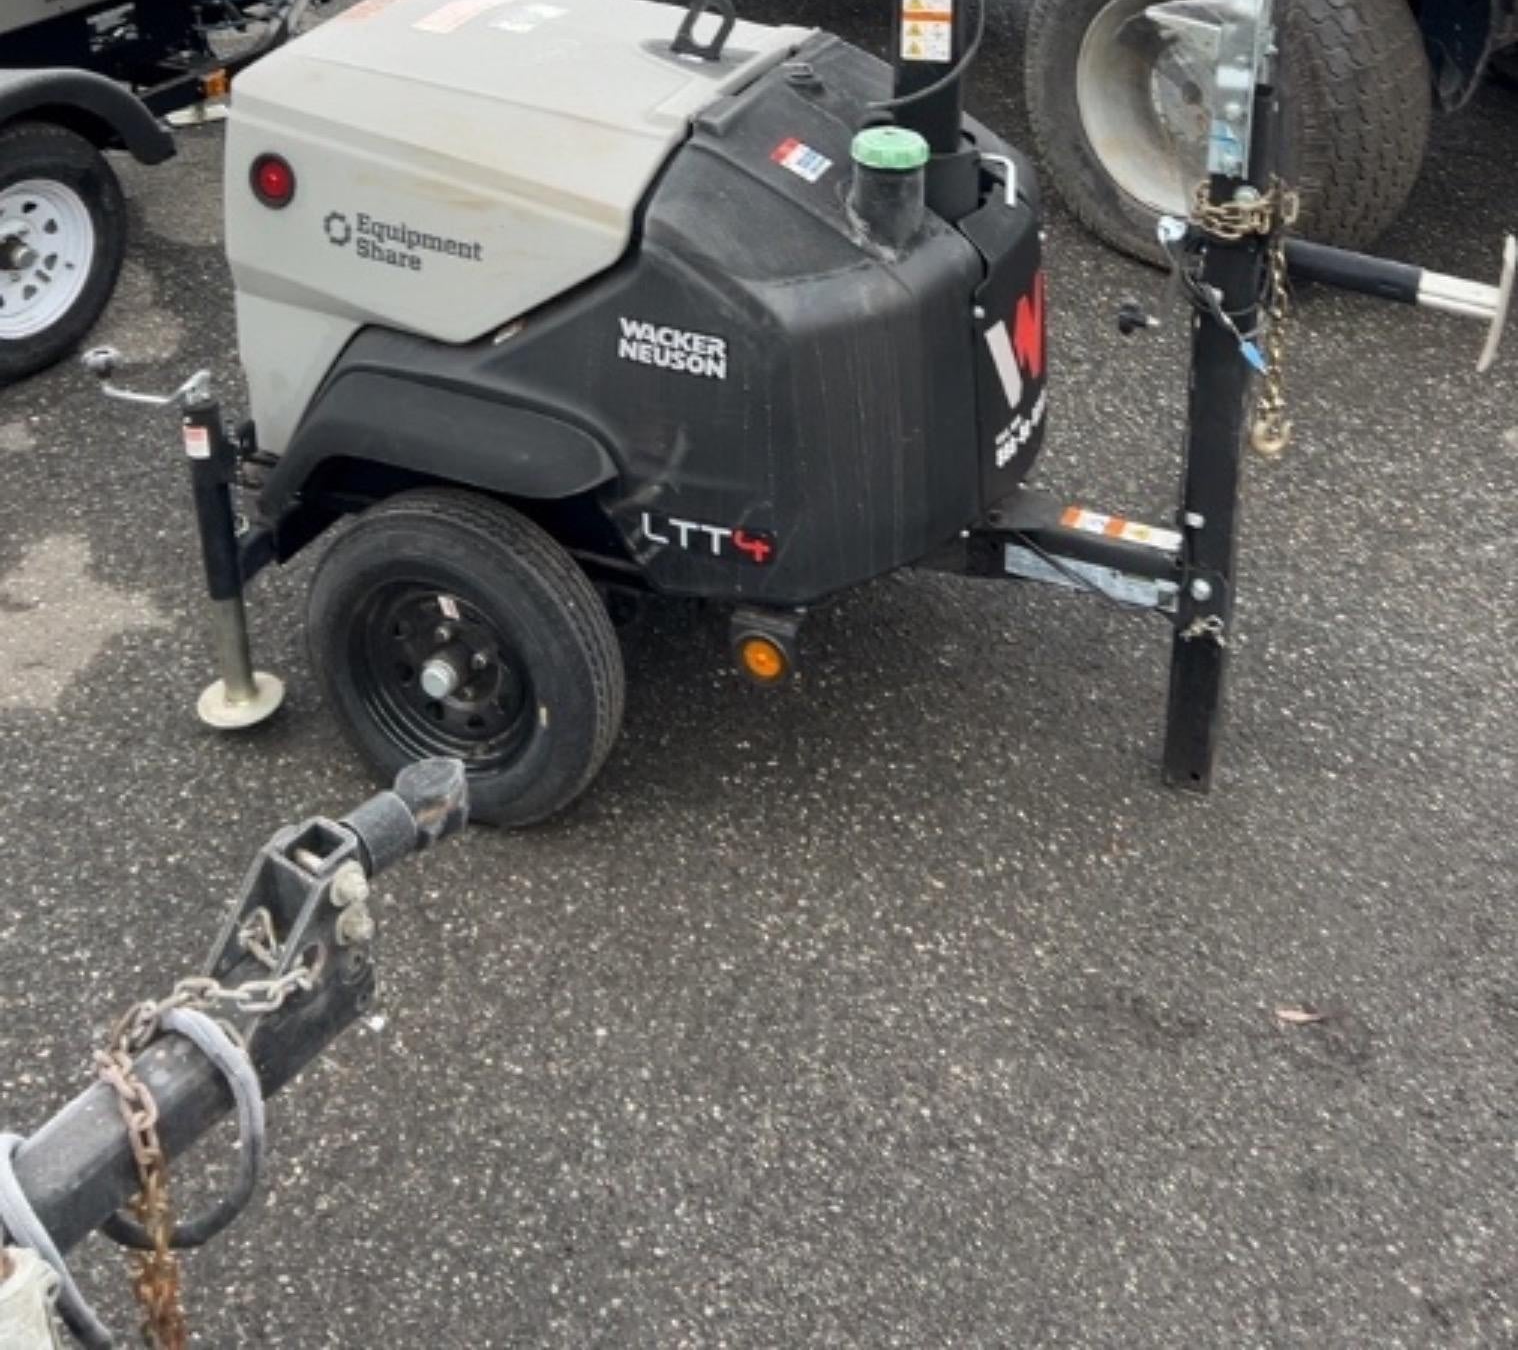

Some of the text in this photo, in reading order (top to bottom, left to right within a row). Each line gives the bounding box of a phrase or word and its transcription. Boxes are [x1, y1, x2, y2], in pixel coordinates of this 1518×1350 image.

[357, 212, 483, 261] Equipment
[357, 237, 421, 270] Share
[619, 317, 727, 357] WACKER
[619, 338, 727, 379] NEUSON
[641, 512, 769, 562] LTT4
